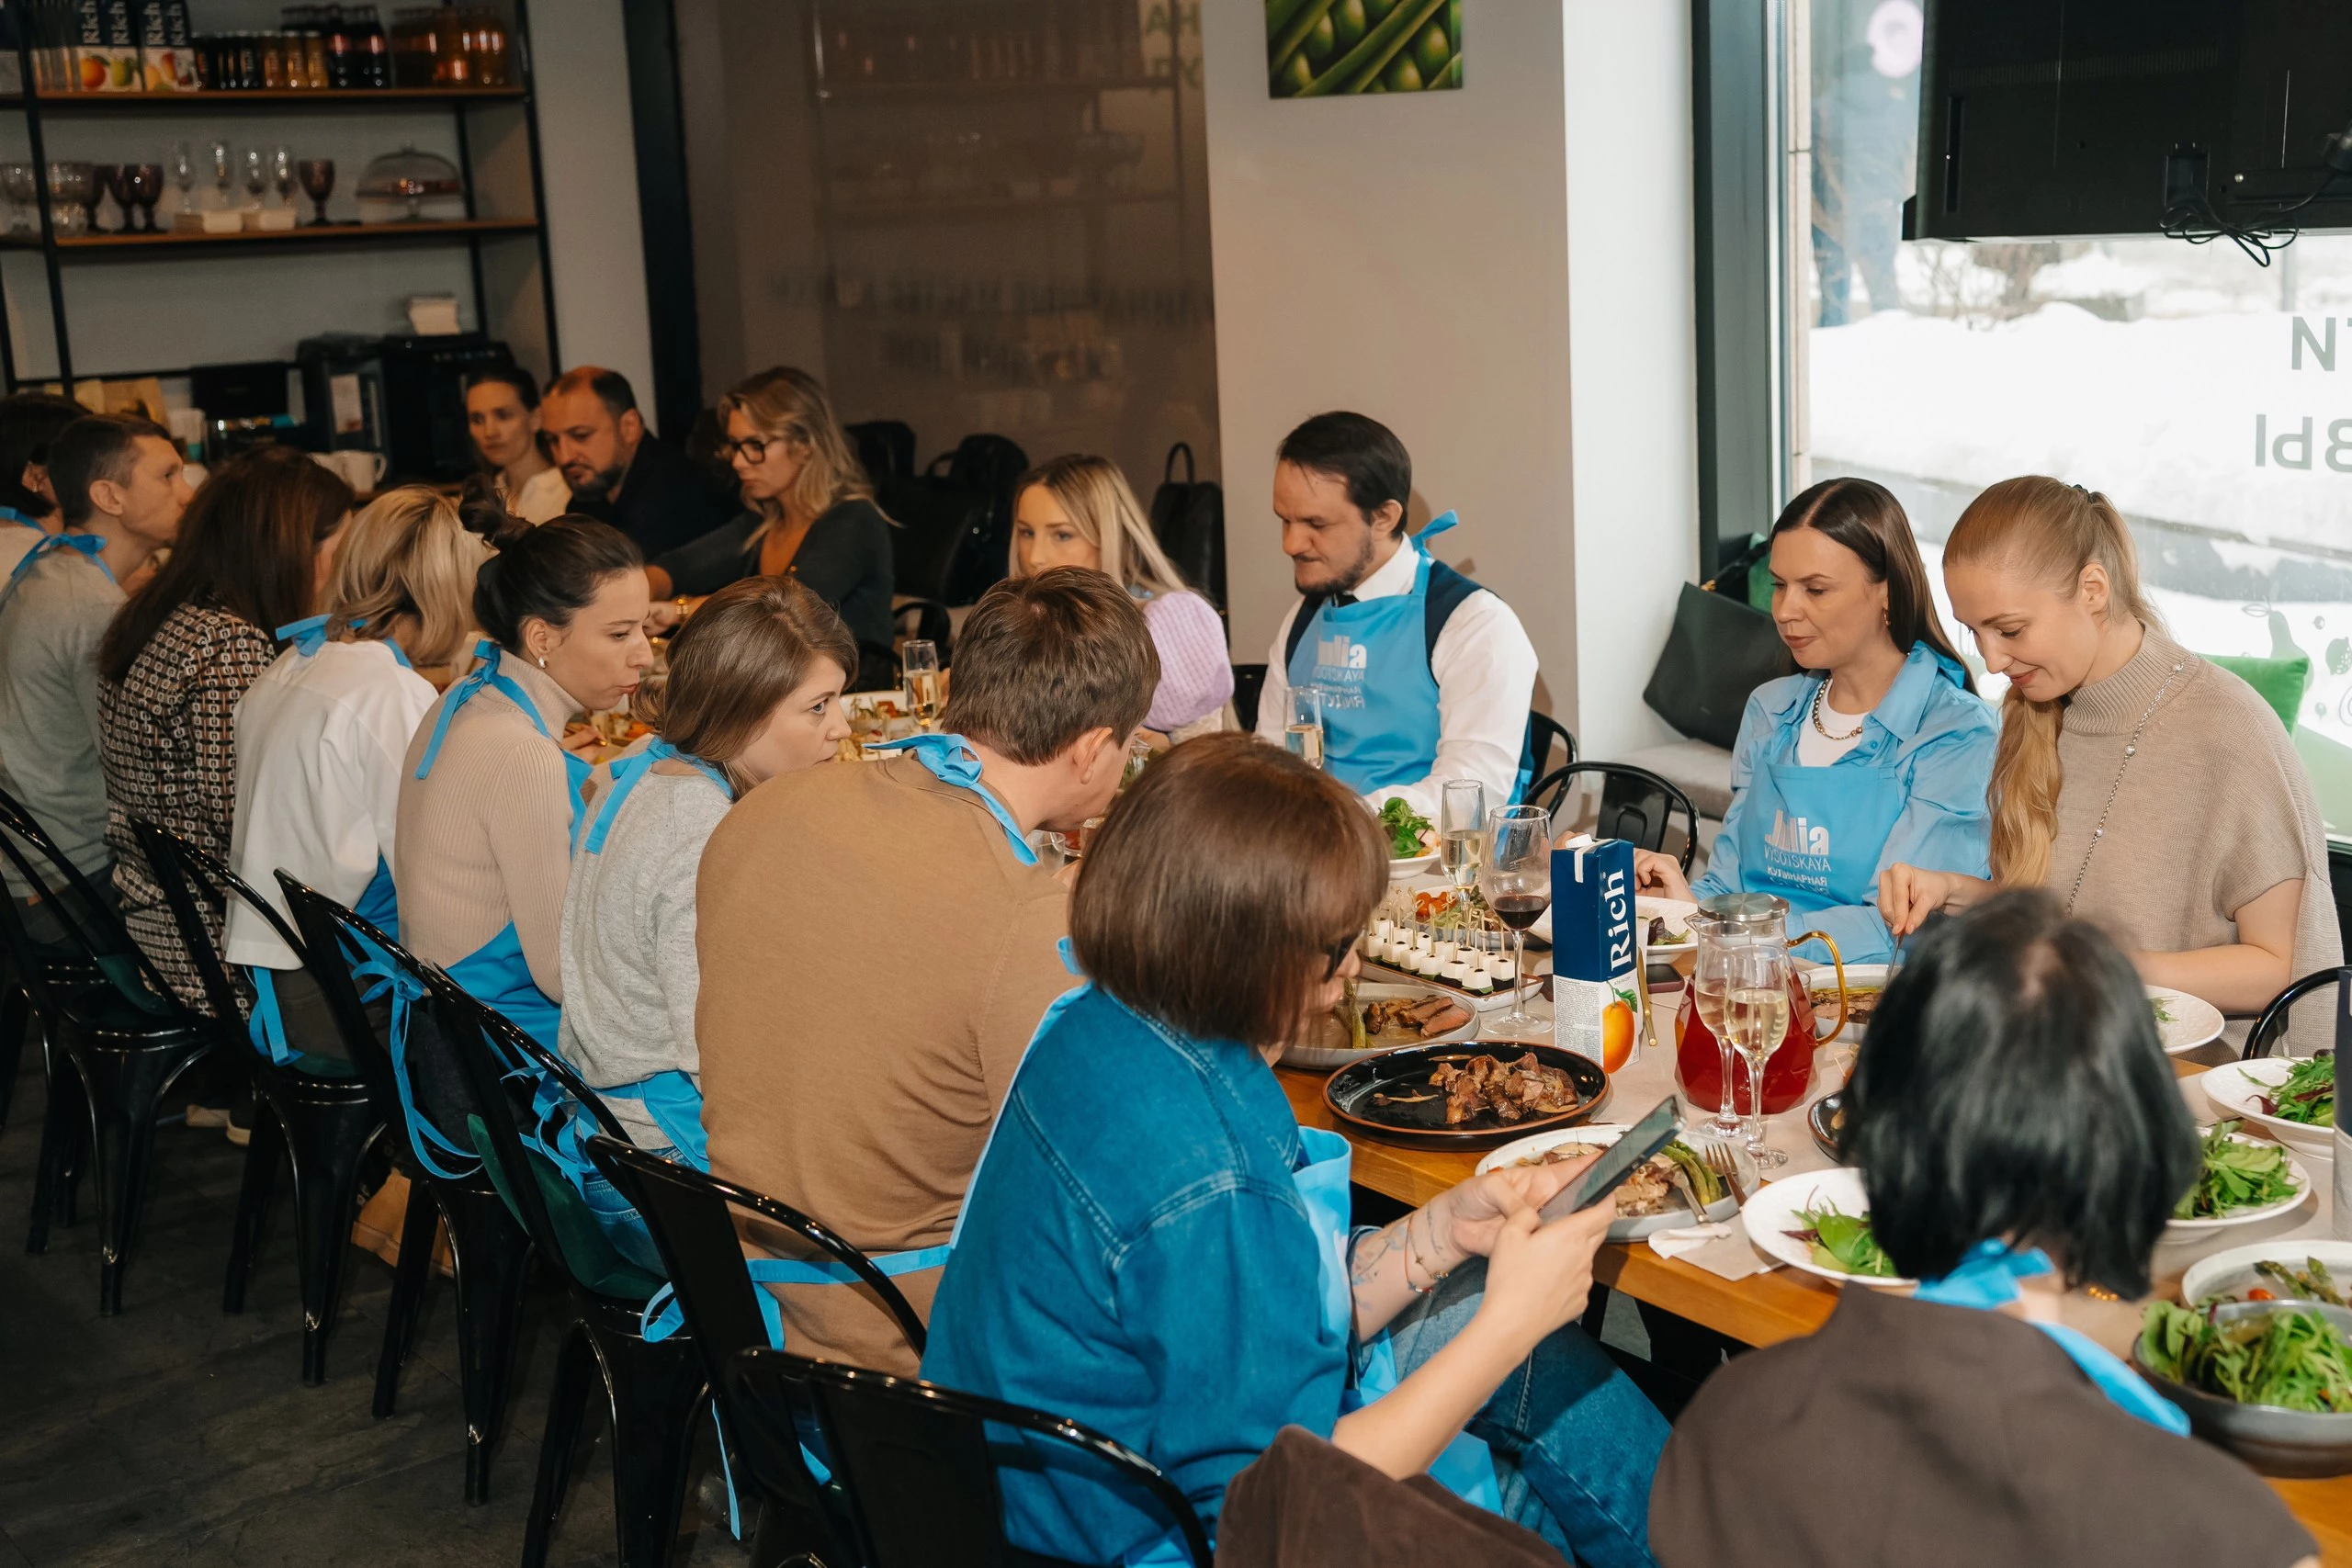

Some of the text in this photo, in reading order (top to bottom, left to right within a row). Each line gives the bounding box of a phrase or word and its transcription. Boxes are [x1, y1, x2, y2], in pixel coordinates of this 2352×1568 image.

[1764, 808, 1829, 855] Julia
[1764, 843, 1832, 873] VYSOTSKAYA
[1767, 865, 1827, 887] КУЛИНАРНАЯ
[1604, 868, 1633, 972] Rich
